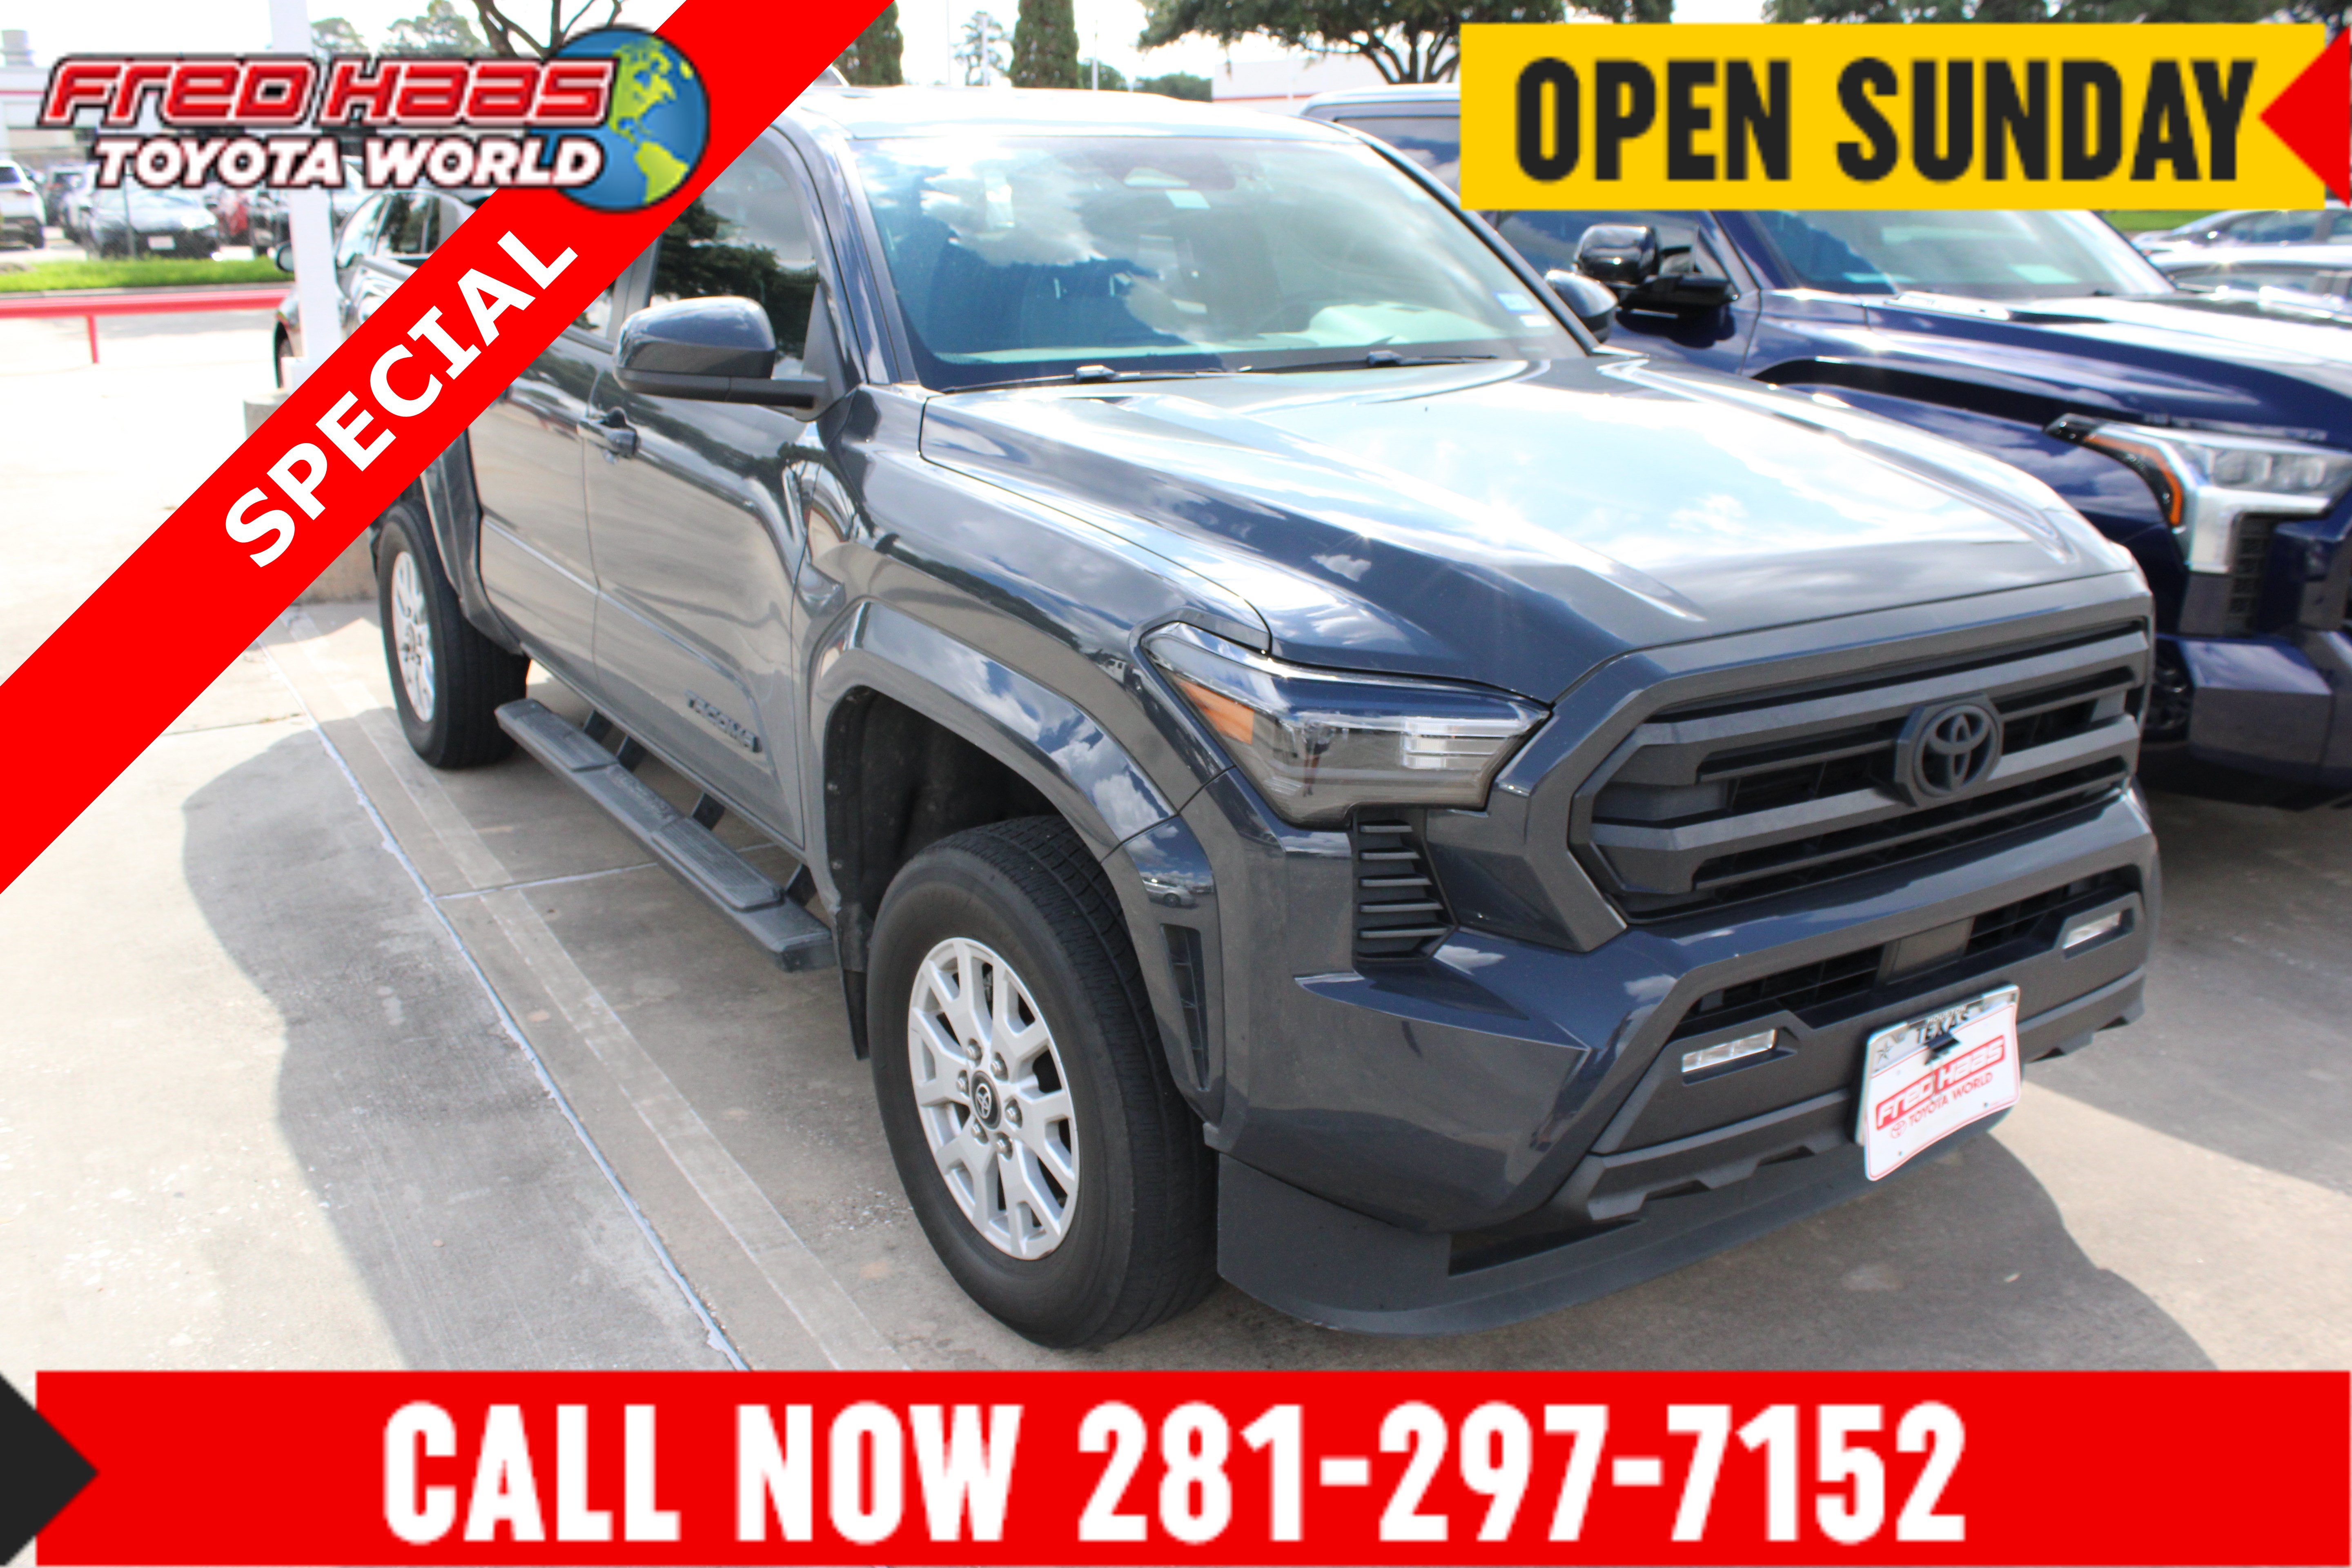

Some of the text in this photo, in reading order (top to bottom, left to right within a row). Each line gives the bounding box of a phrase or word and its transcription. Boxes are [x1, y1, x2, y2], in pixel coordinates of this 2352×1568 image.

[1915, 1010, 1969, 1045] TEXAS
[1909, 1072, 1993, 1126] TOYOTA WORLD
